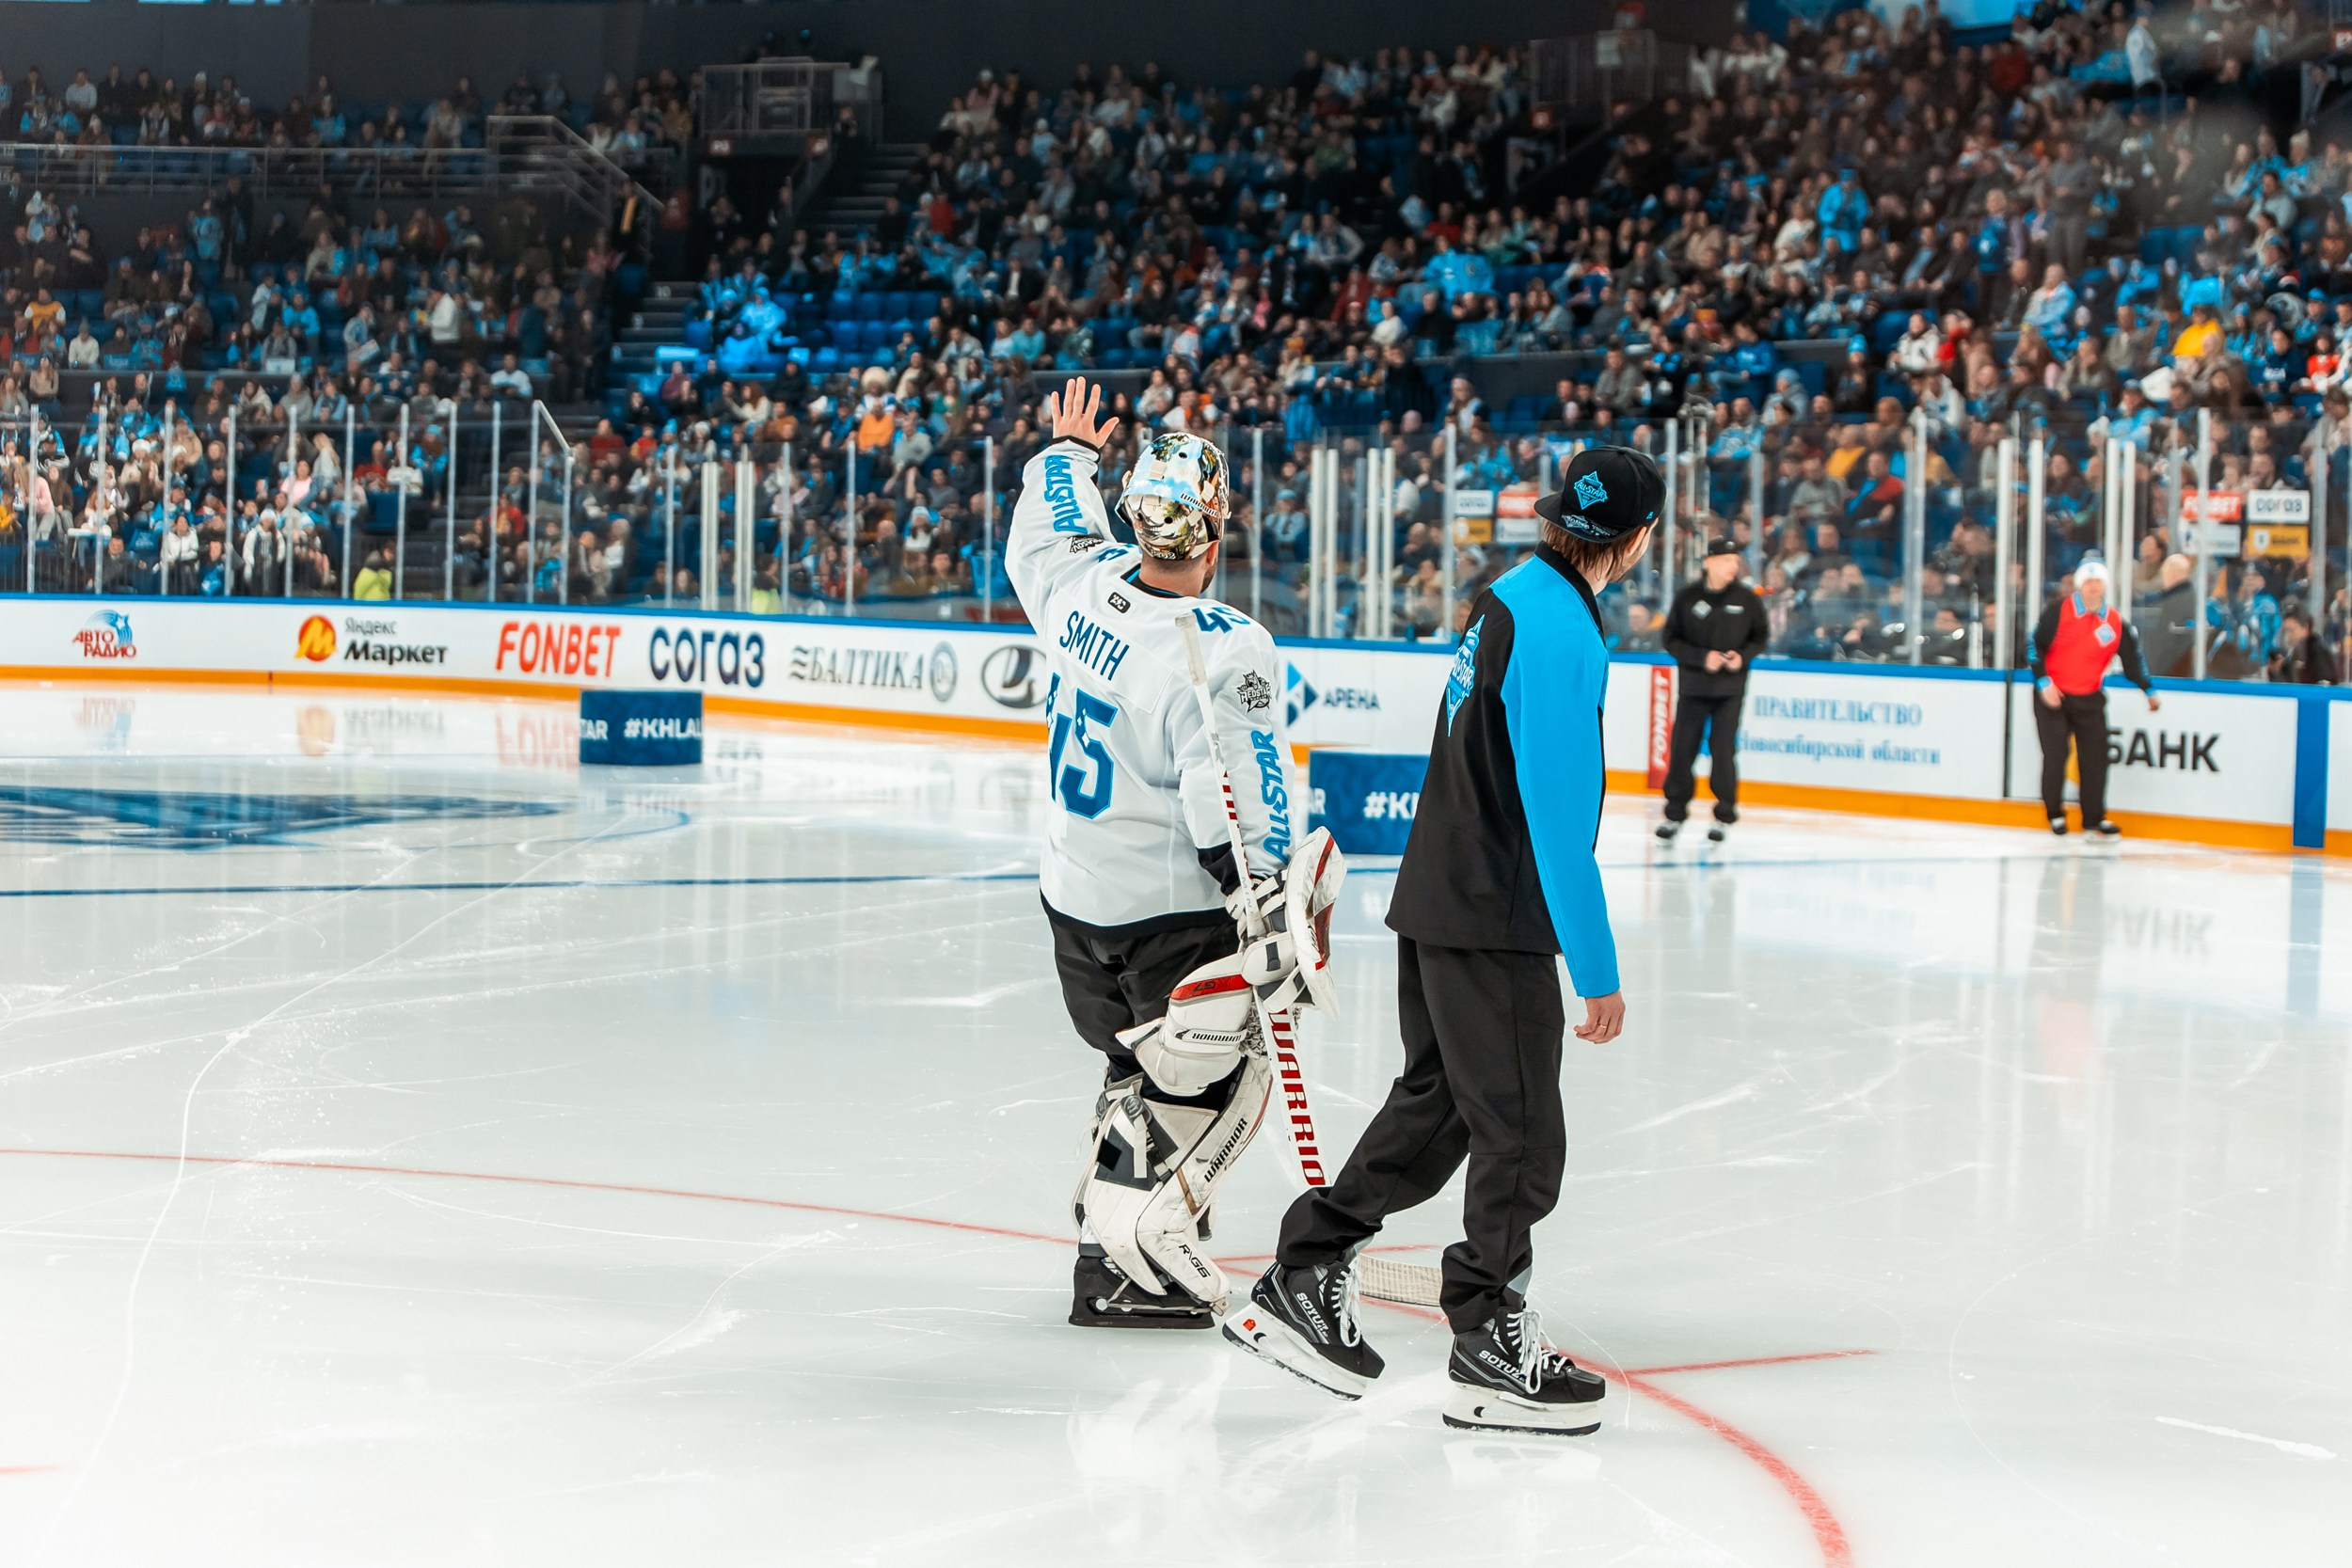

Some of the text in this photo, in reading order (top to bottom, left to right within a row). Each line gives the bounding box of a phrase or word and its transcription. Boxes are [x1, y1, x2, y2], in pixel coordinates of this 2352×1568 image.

[72, 629, 115, 643] АВТО
[344, 616, 397, 635] Яндекс
[83, 642, 137, 658] РАДИО
[344, 639, 449, 666] Маркет
[495, 620, 622, 678] FONBET
[1059, 610, 1131, 682] SMITH
[810, 644, 925, 689] БАЛТИКА
[1323, 688, 1381, 711] АРЕНА
[1754, 694, 1923, 726] ПРАВИТЕЛЬСТВО
[1653, 669, 1669, 768] FONBET
[1737, 728, 1942, 765] Новосибирской области
[1203, 1117, 1248, 1183] WARRIOR
[1295, 1291, 1329, 1333] SOYUZ
